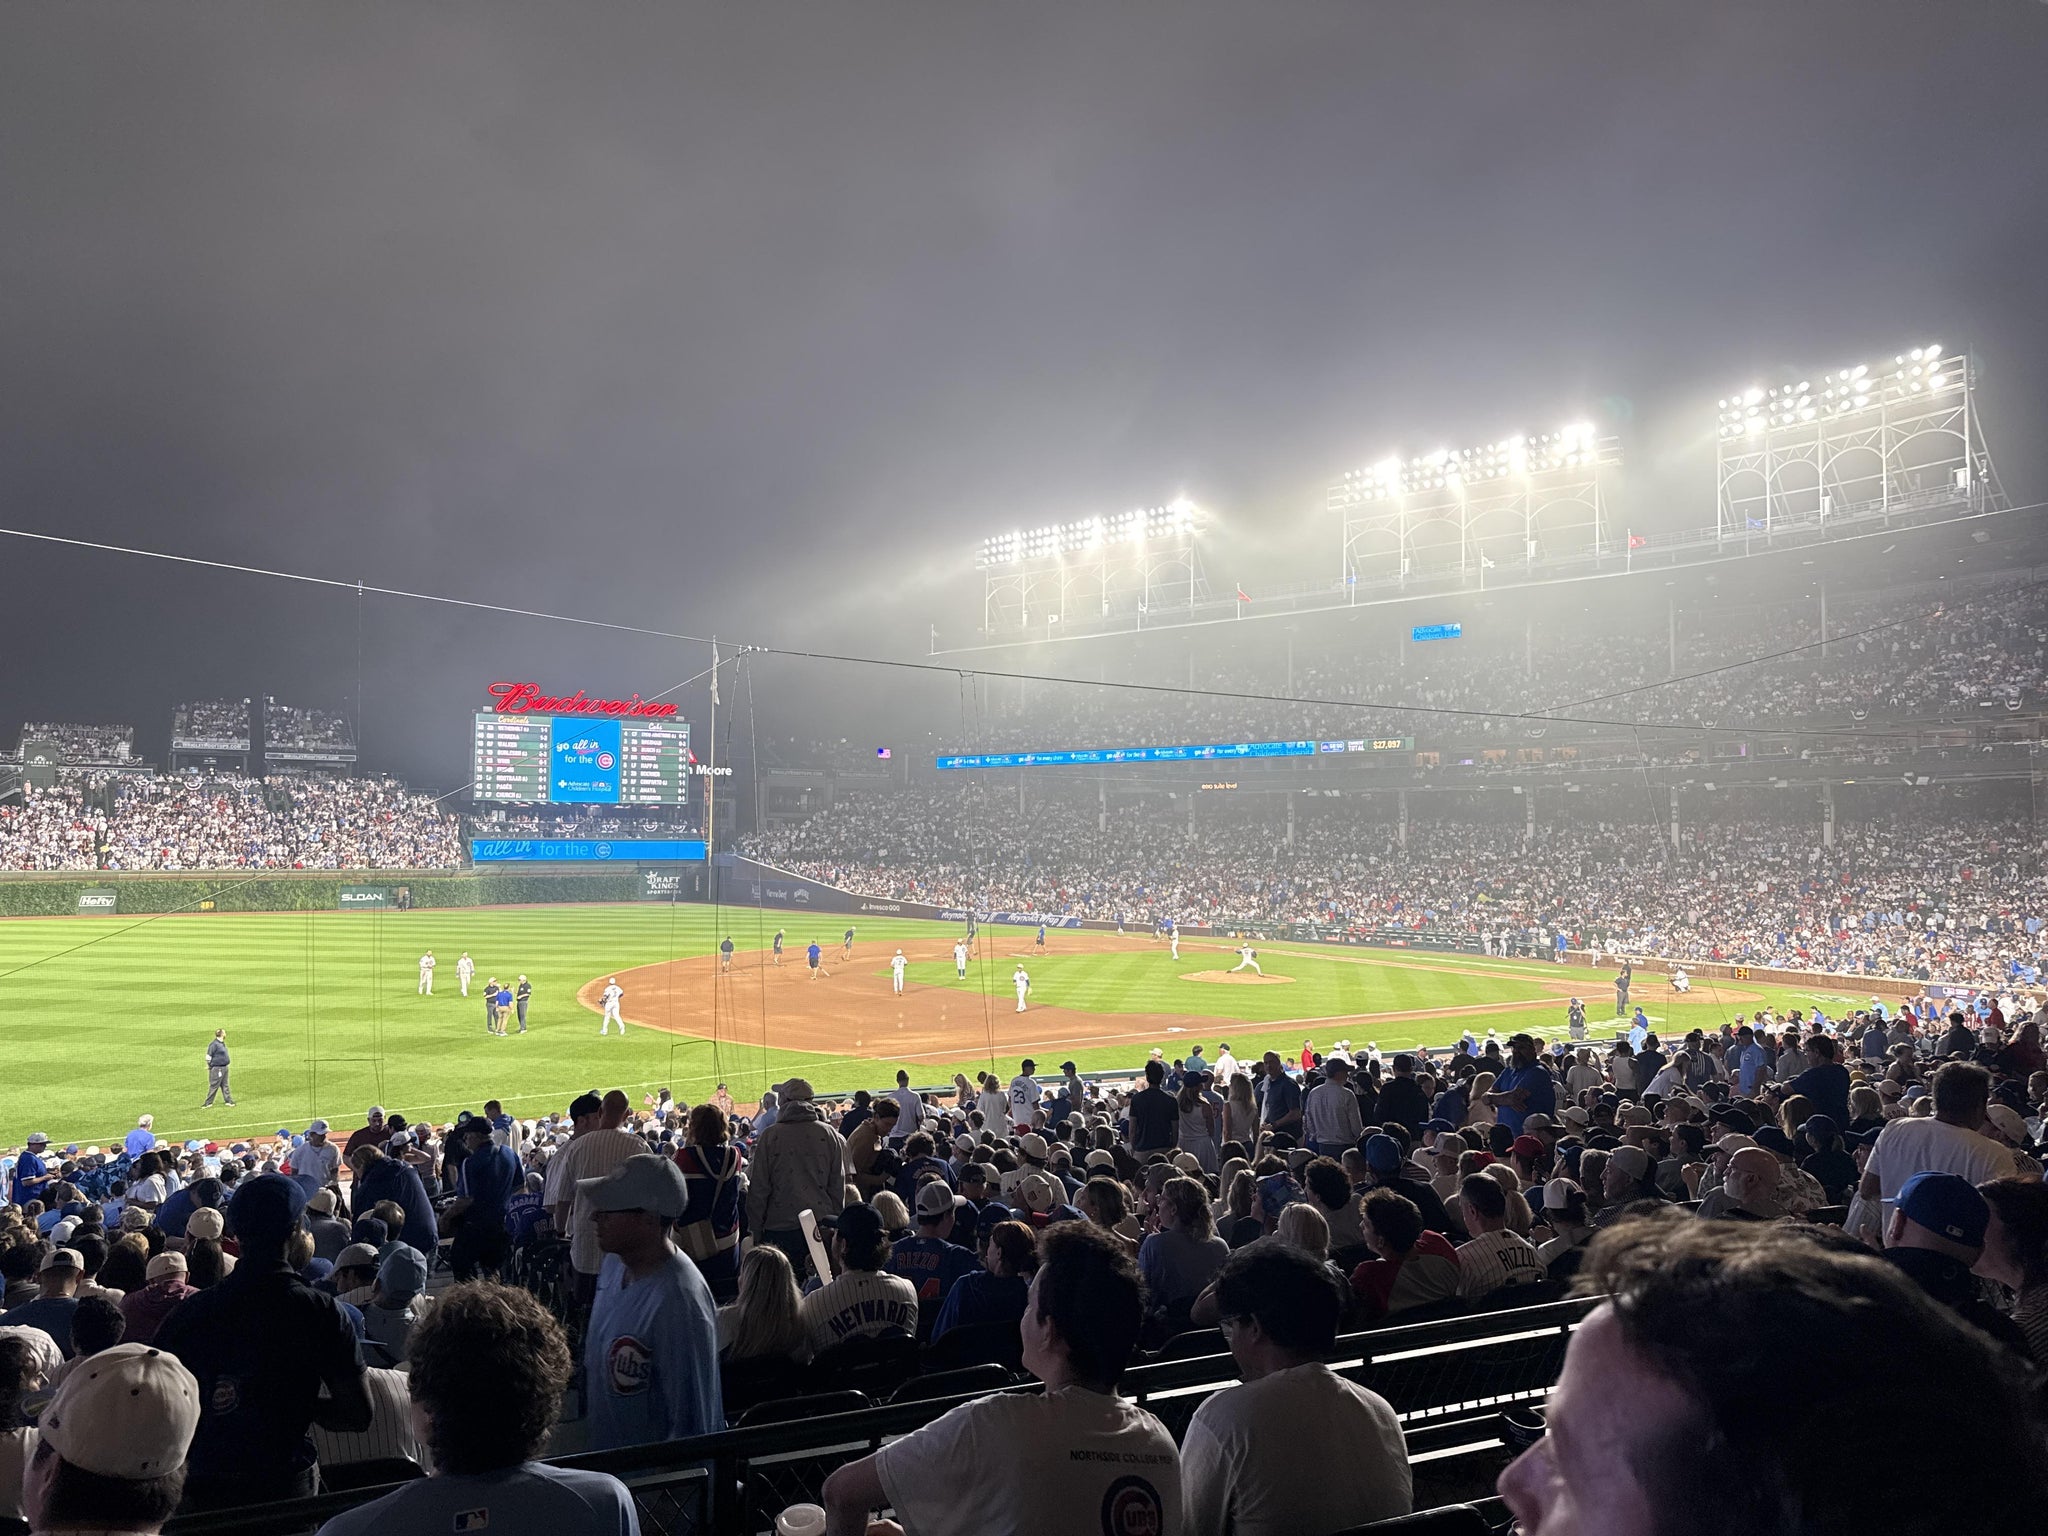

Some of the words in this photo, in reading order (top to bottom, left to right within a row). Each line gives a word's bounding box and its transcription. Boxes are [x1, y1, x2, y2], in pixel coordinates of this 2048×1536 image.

[488, 682, 679, 718] Budweiser
[498, 715, 529, 724] Cardinals
[556, 742, 569, 752] go
[572, 739, 588, 750] all
[590, 739, 599, 748] in
[564, 754, 576, 763] for
[579, 755, 593, 763] the
[696, 764, 732, 776] Moore
[484, 841, 512, 856] all
[515, 841, 532, 854] in
[540, 842, 562, 856] for
[565, 842, 588, 856] the
[647, 876, 680, 884] DRAFT
[81, 897, 113, 906] Hefty
[341, 893, 382, 901] SLOAN
[1007, 913, 1039, 924] Reynolds
[1039, 914, 1059, 926] Wrap
[1013, 1090, 1026, 1105] 23
[897, 1252, 940, 1271] RIZZO
[1497, 1246, 1535, 1272] RIZZO
[828, 1300, 908, 1338] HEYWARD
